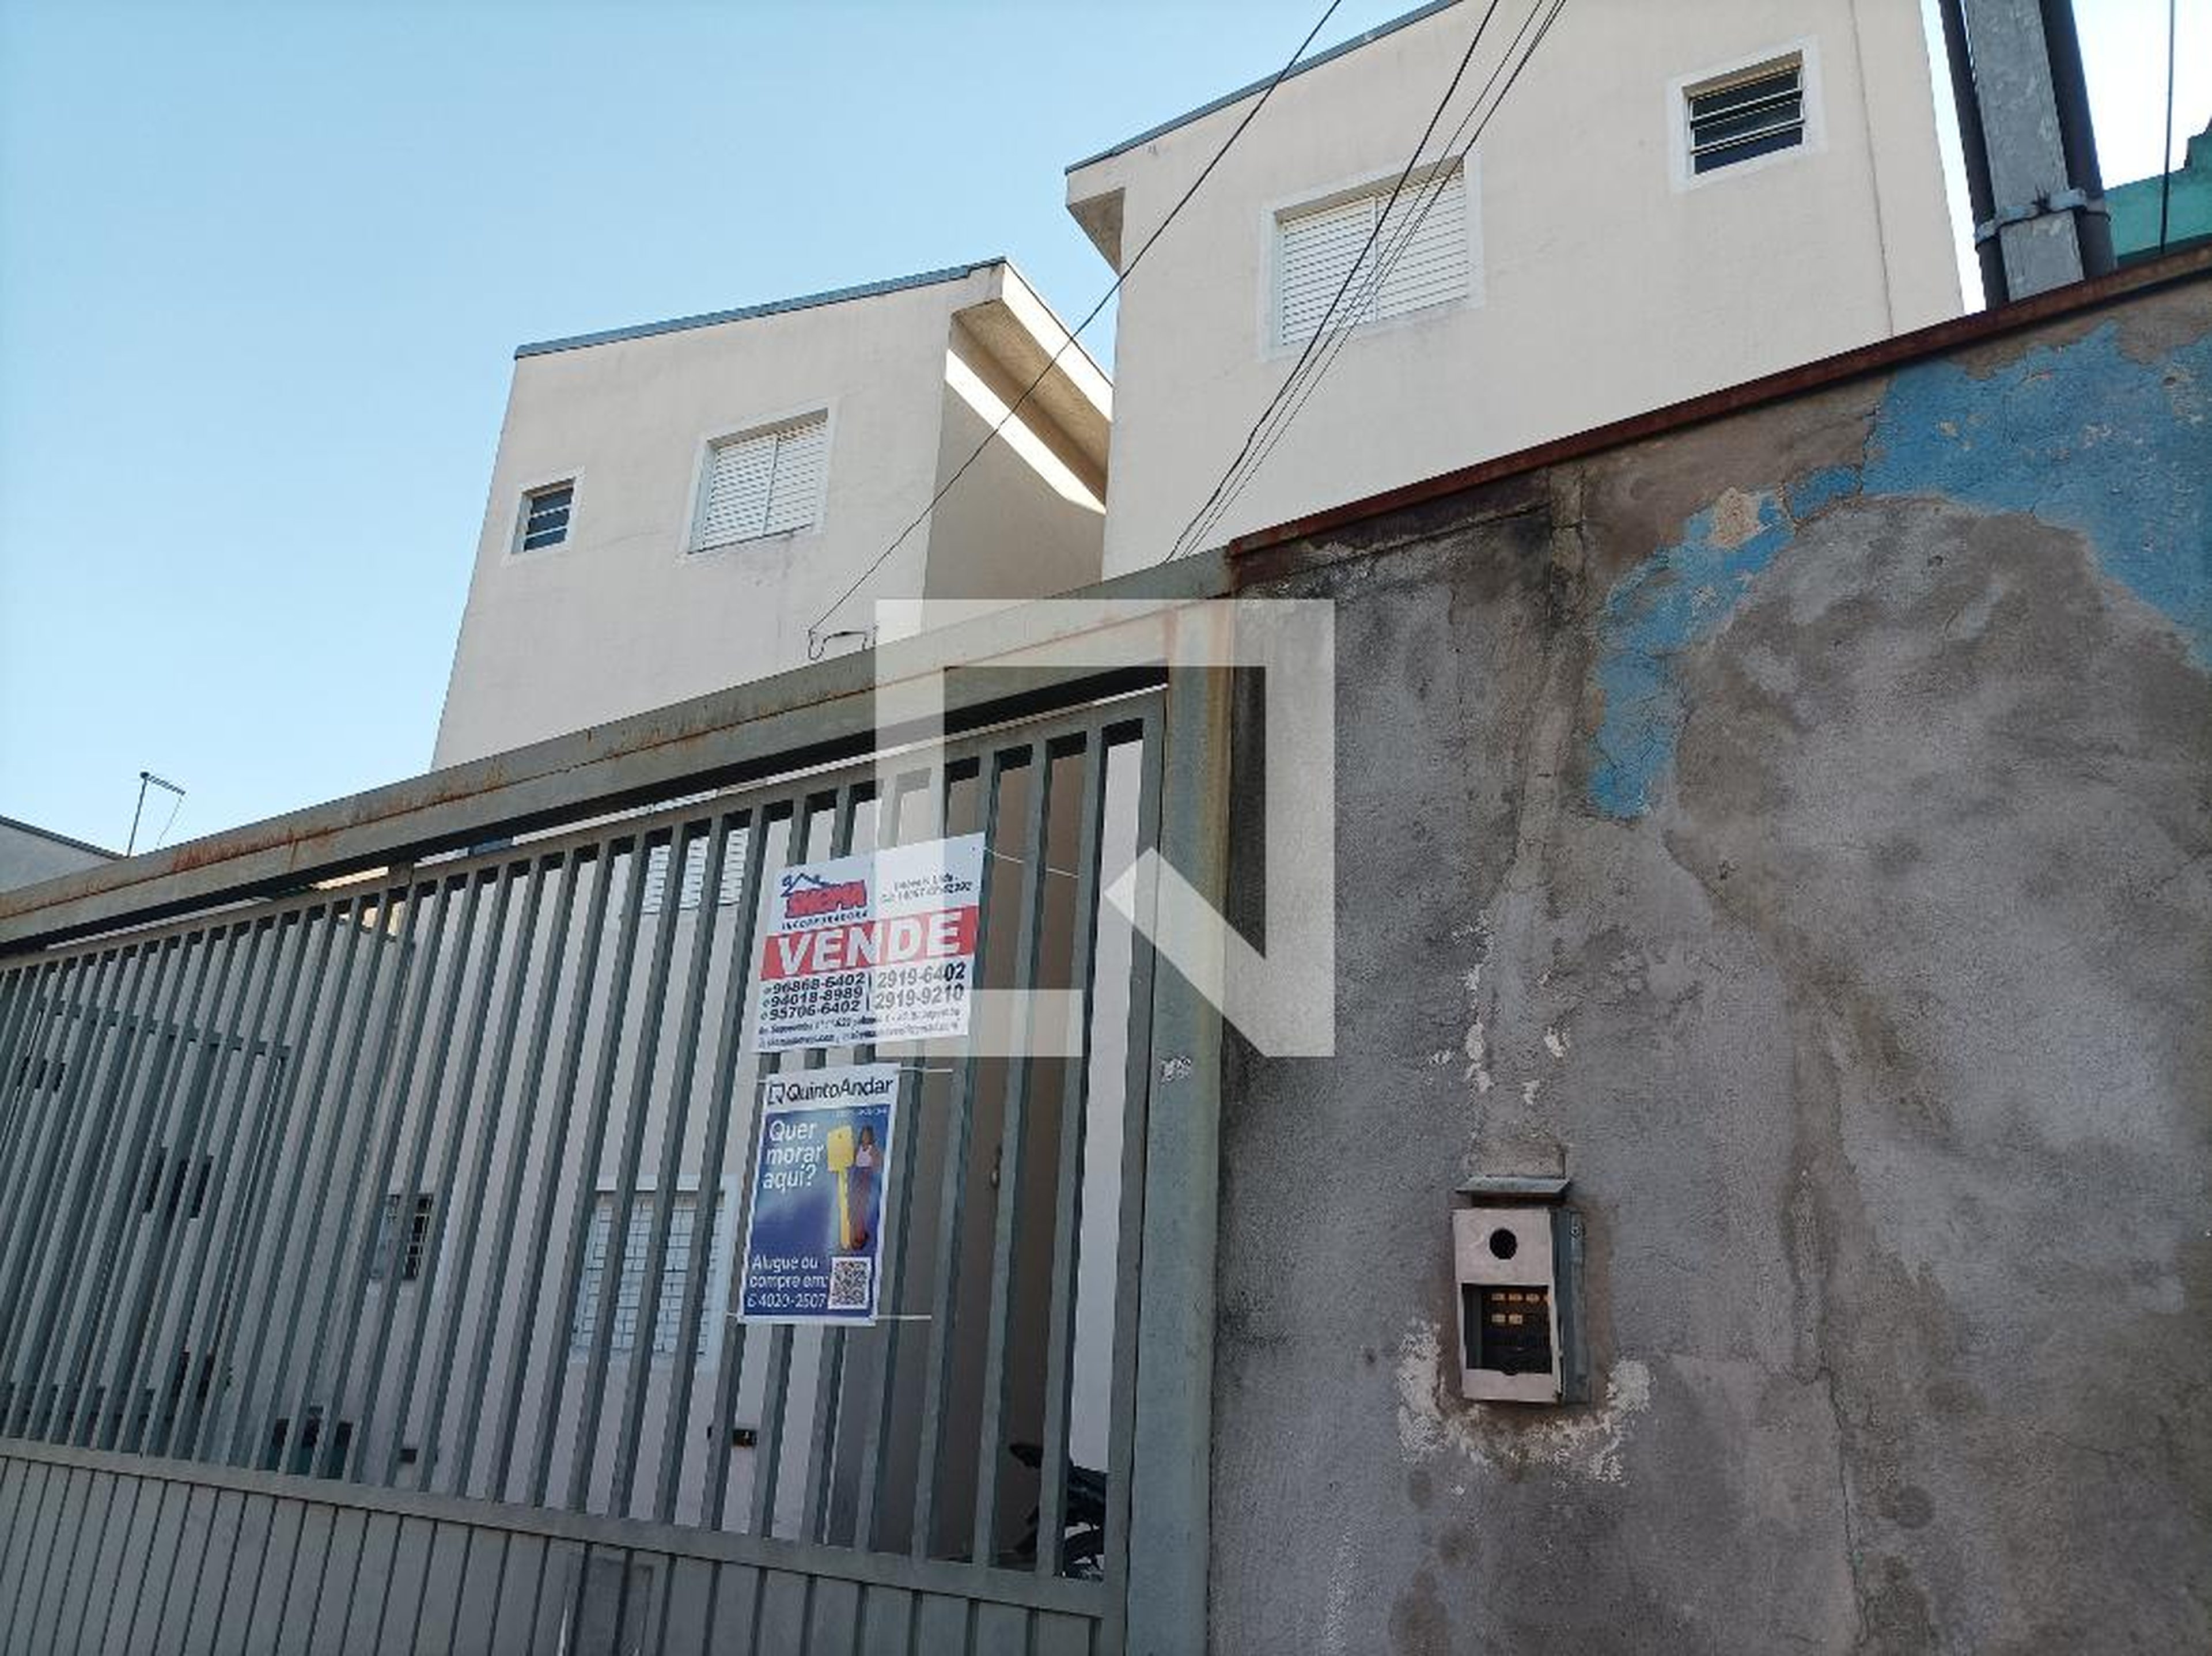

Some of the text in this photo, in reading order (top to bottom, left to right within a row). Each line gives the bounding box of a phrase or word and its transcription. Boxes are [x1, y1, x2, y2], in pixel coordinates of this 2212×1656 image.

[778, 911, 963, 976] VENDE
[878, 961, 966, 988] 2919-6402
[875, 983, 964, 1010] 2919-9210
[786, 1077, 893, 1102] QuintoAndar
[769, 1120, 817, 1142] Quer
[766, 1144, 824, 1165] morar
[763, 1164, 816, 1193] aqui?
[752, 1254, 818, 1273] Alugue ou
[750, 1276, 801, 1292] compre
